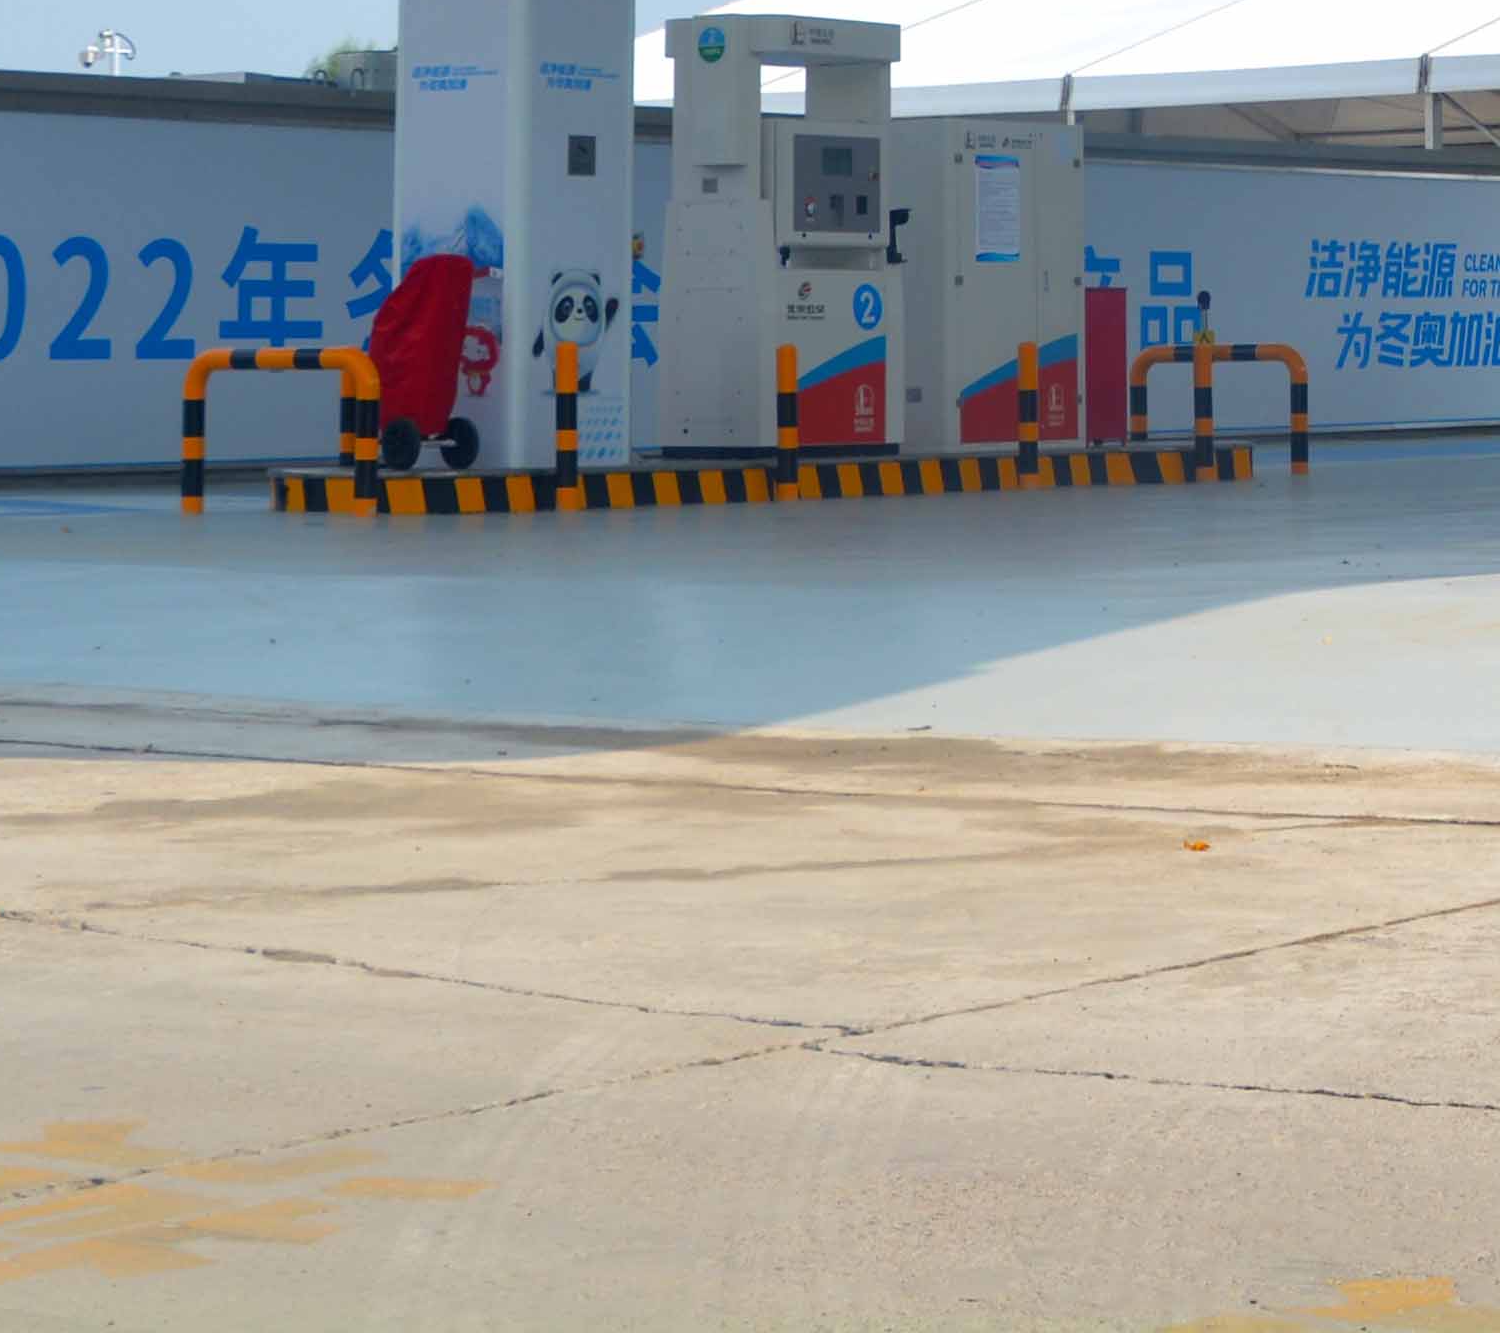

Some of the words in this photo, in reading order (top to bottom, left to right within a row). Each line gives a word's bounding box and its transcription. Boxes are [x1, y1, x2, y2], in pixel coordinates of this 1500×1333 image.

[1304, 238, 1457, 299] 洁净能源
[1461, 279, 1487, 298] FOR
[860, 290, 876, 324] 2
